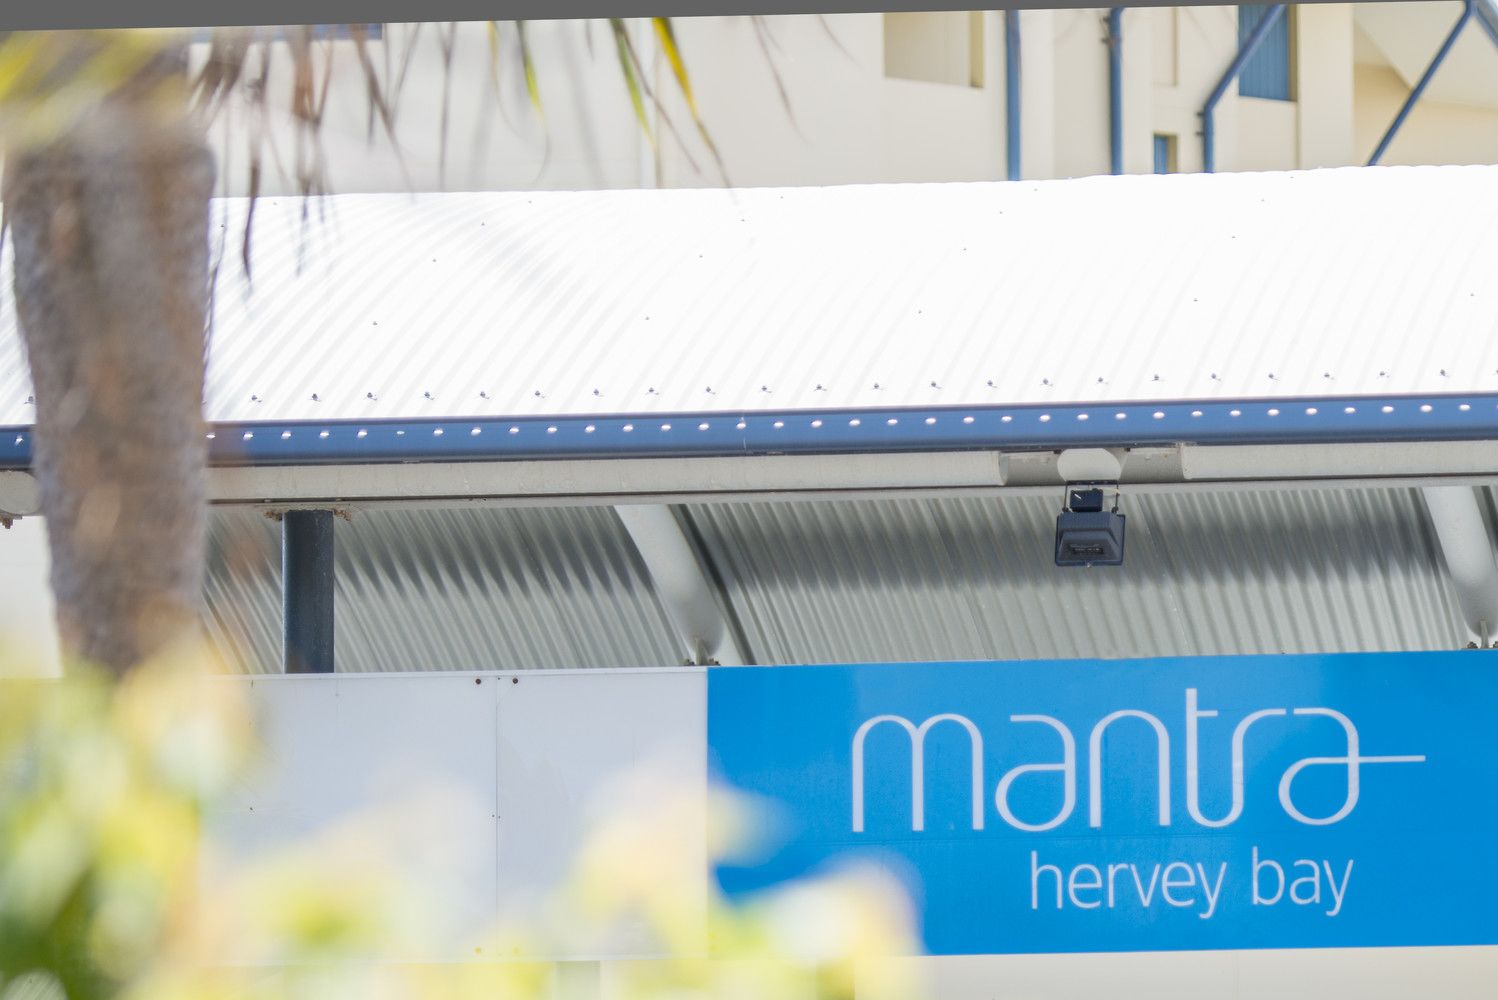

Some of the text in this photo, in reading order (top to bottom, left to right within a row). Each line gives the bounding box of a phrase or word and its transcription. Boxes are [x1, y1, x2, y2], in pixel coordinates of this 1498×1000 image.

[850, 687, 1426, 832] mantra
[1031, 846, 1355, 920] hervey bay
